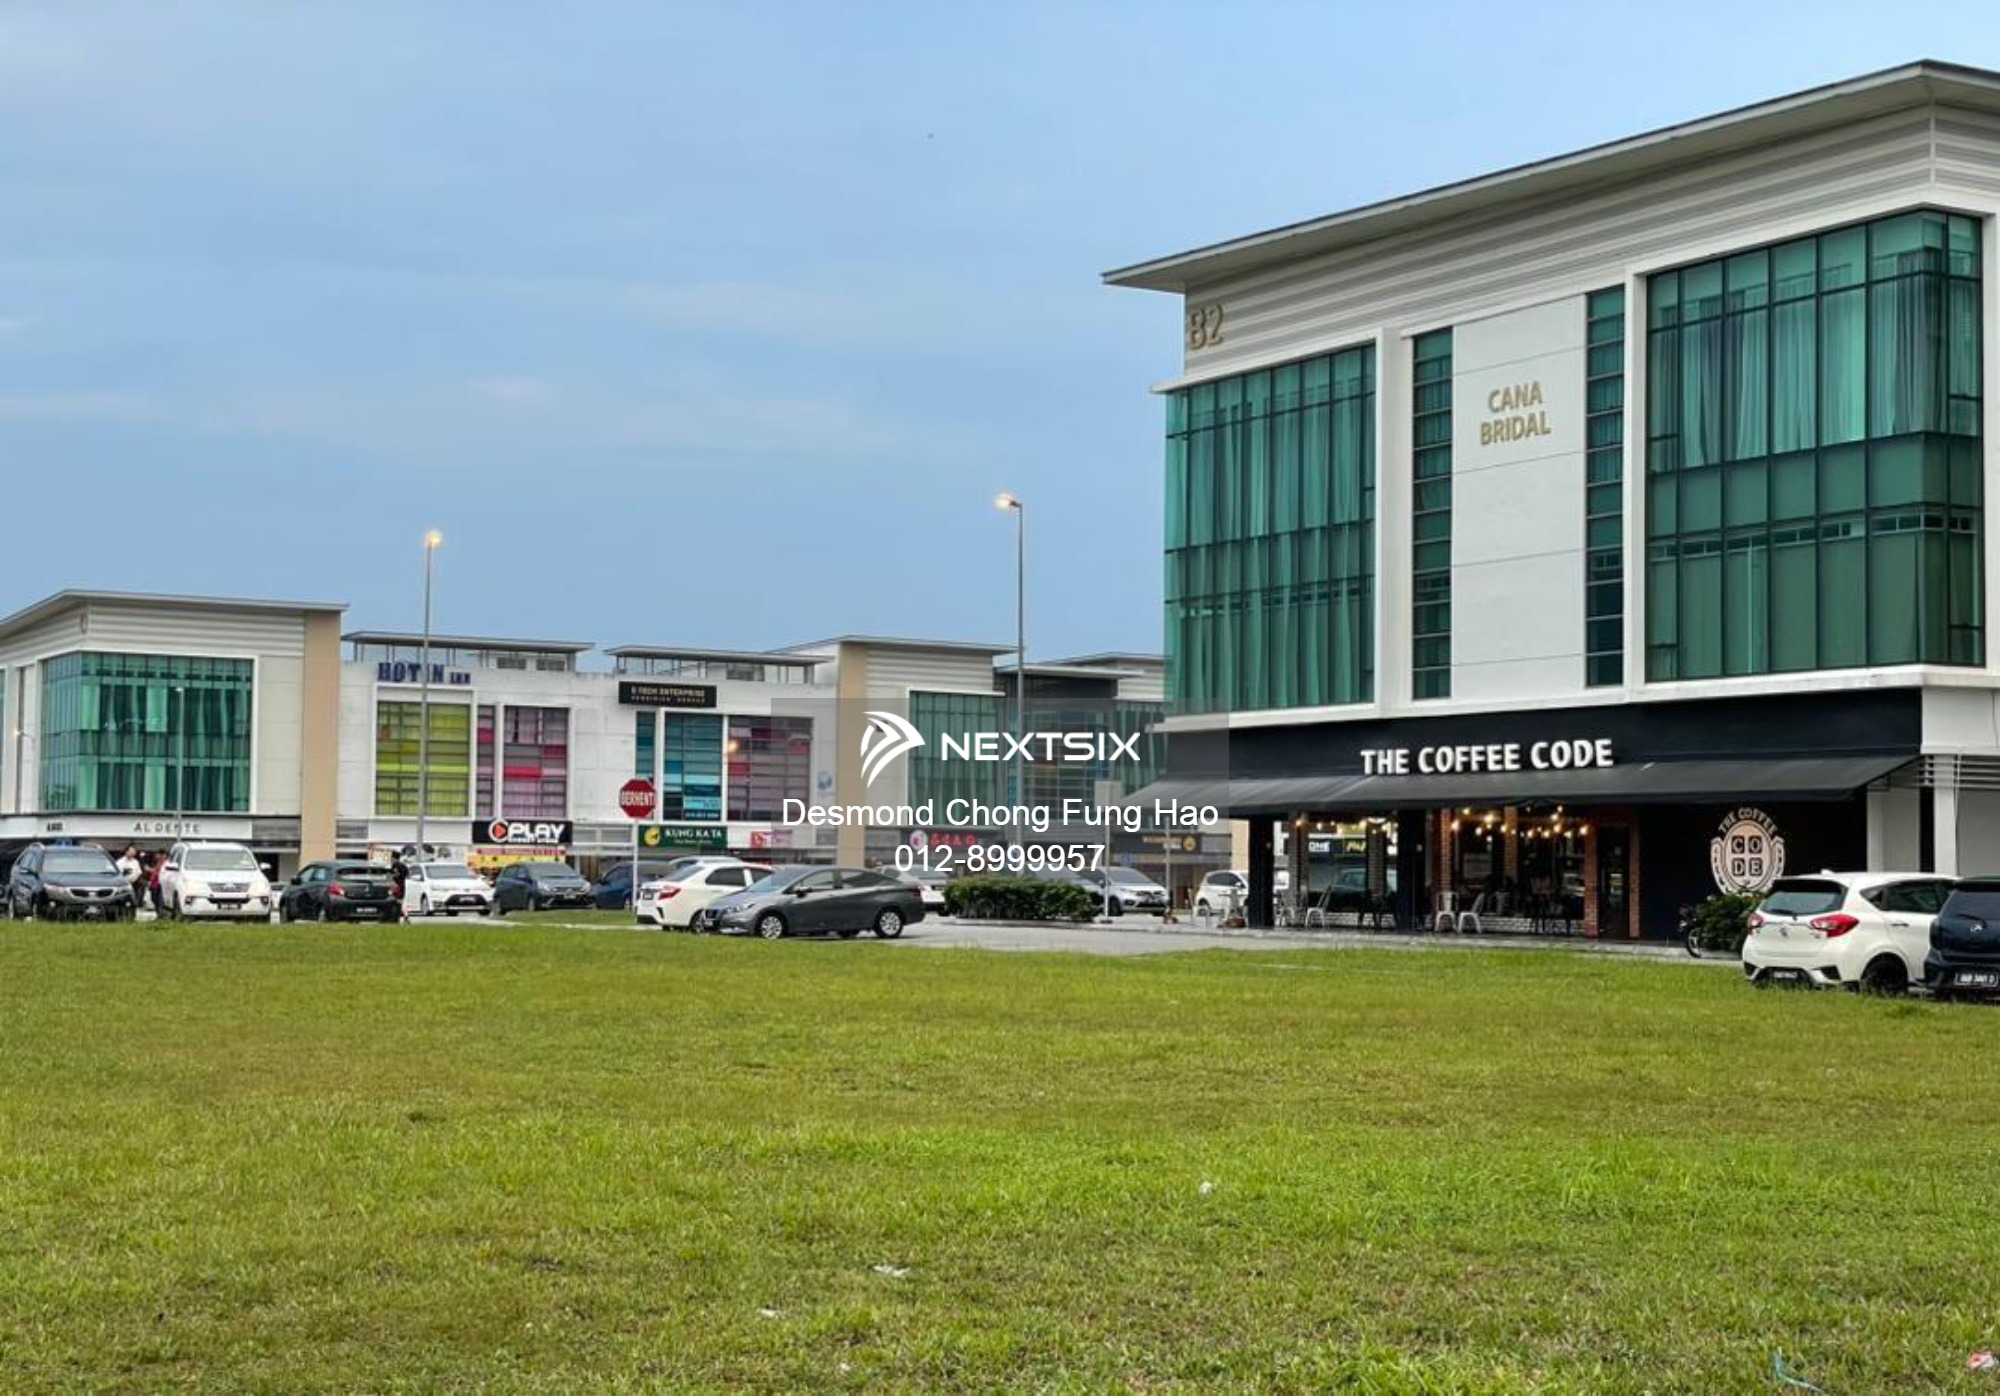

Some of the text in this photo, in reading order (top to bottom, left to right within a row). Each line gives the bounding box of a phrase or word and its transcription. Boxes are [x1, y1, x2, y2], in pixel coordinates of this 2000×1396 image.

[1190, 302, 1223, 350] B2
[1488, 381, 1543, 413] CANA
[1480, 411, 1551, 446] BRIDAL
[1360, 739, 1614, 775] THE COFFEE CODE
[1718, 807, 1778, 836] THE COFFEE
